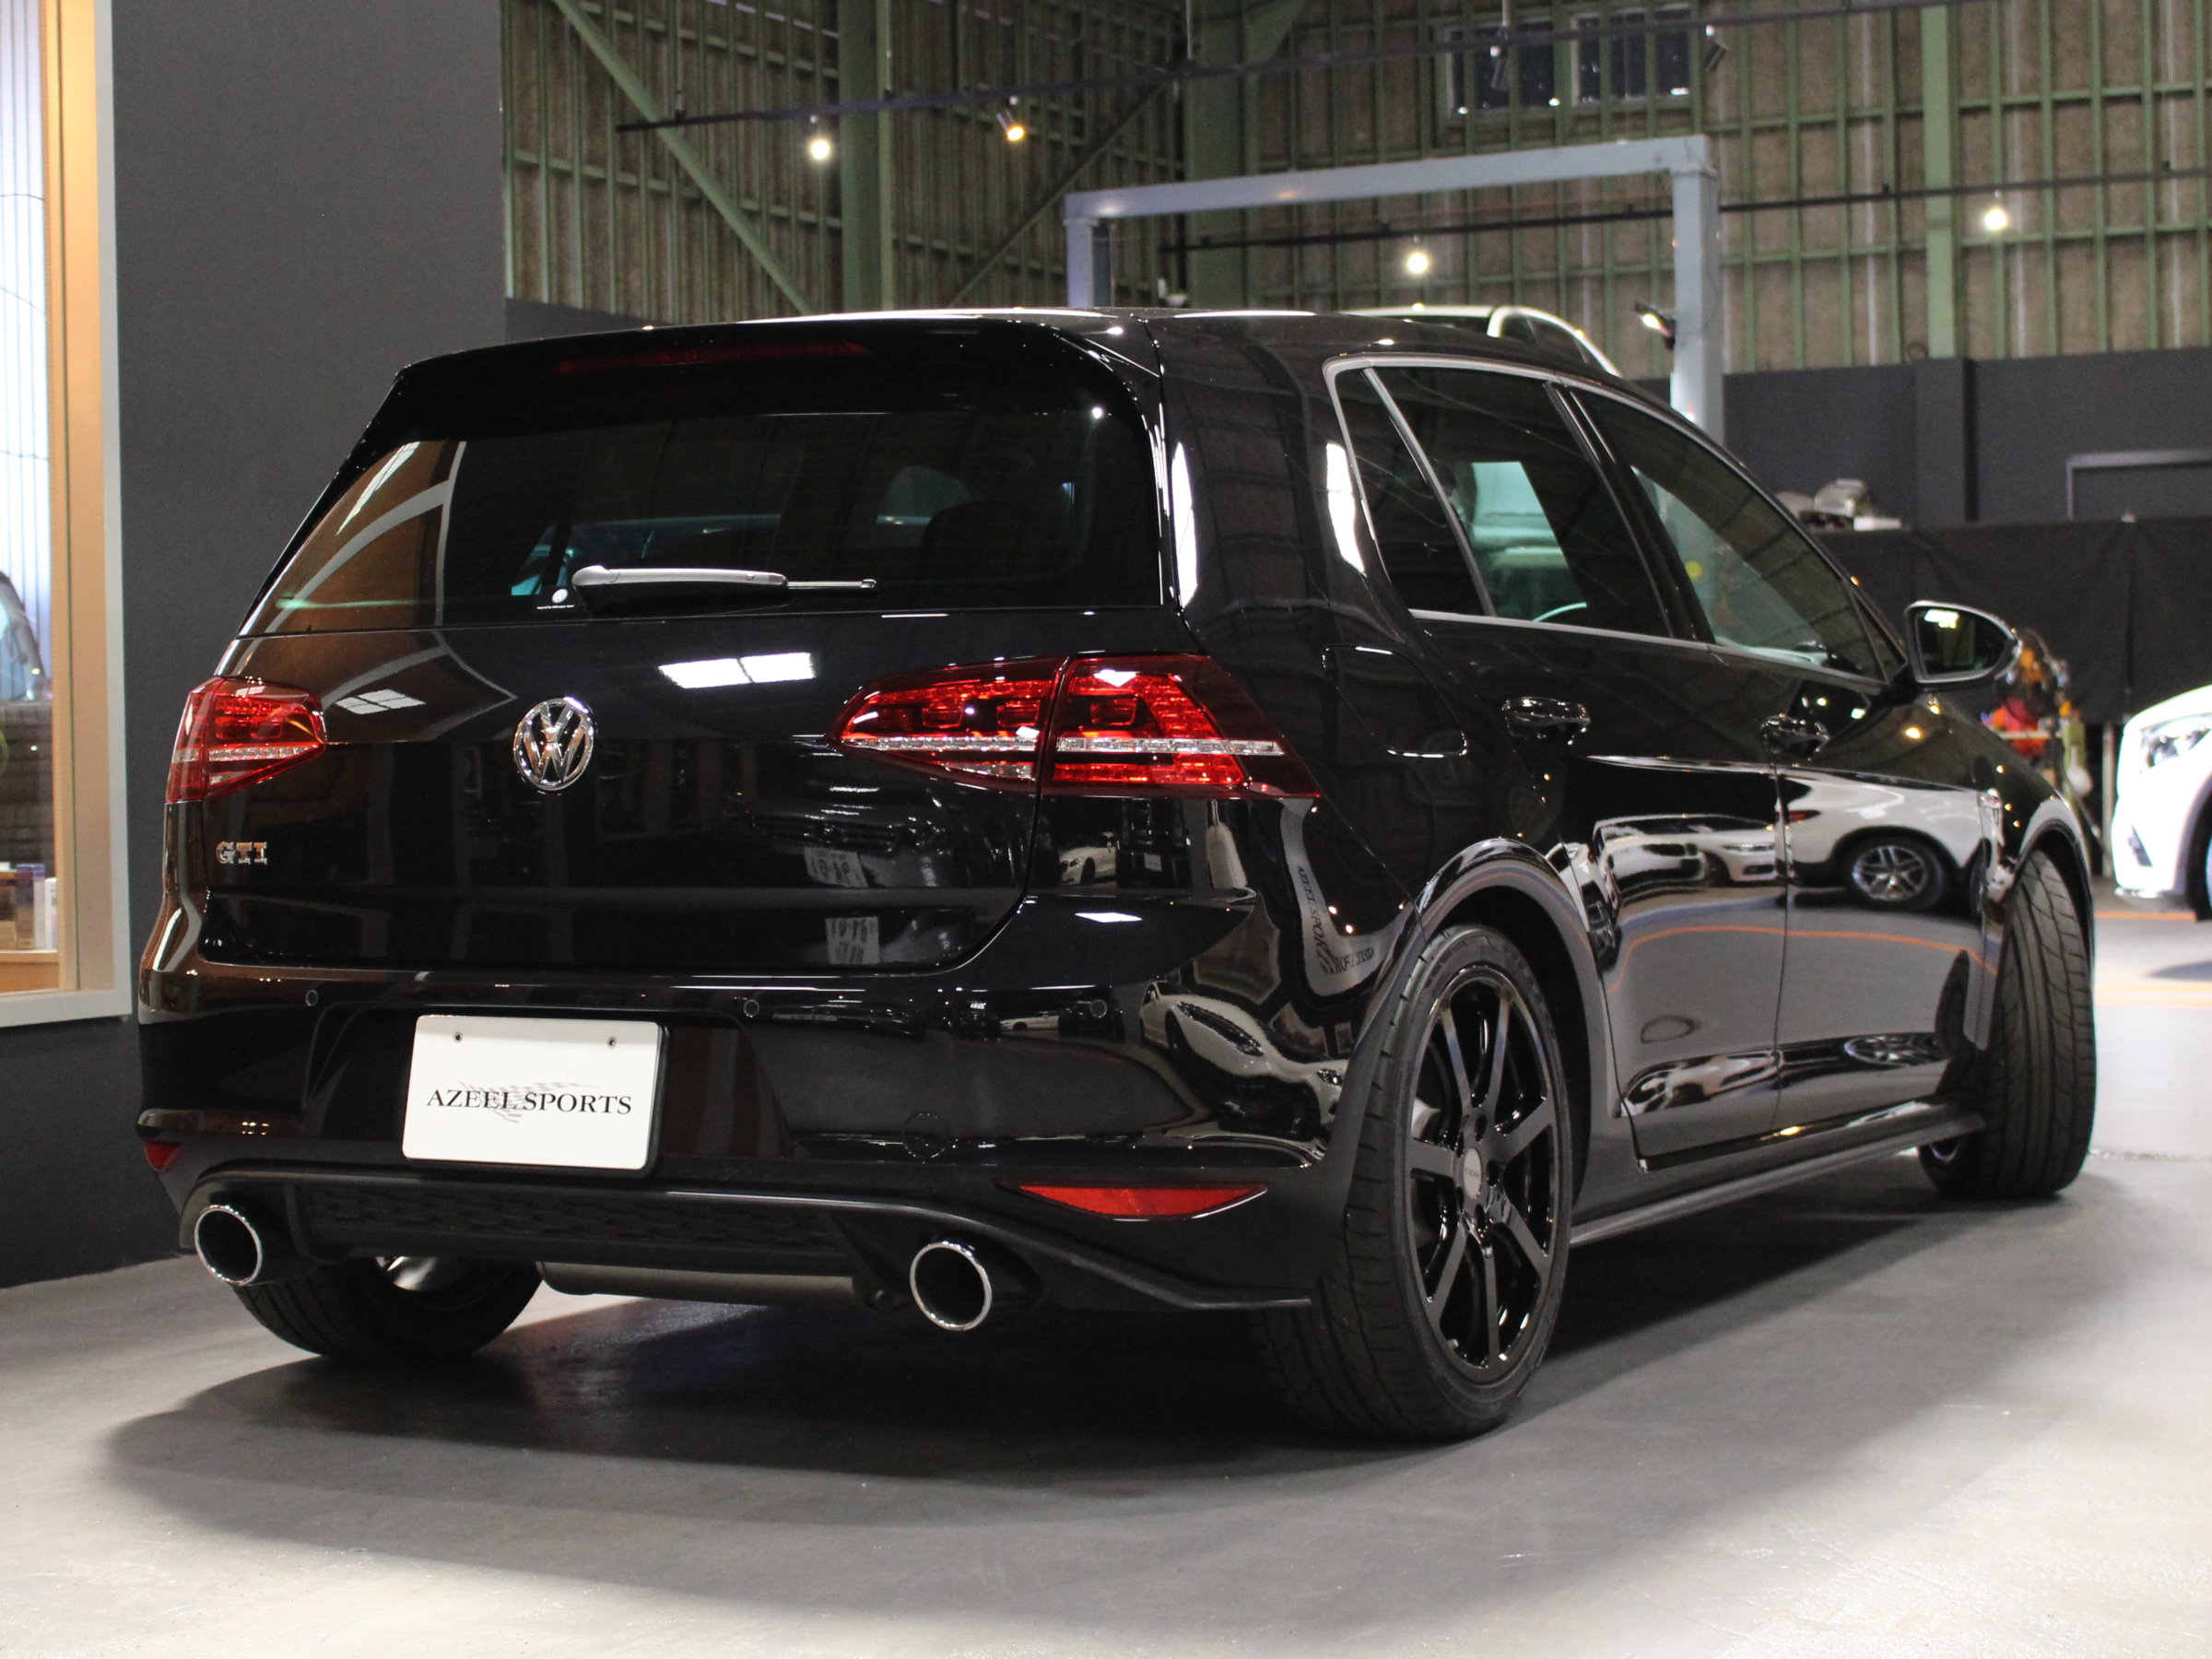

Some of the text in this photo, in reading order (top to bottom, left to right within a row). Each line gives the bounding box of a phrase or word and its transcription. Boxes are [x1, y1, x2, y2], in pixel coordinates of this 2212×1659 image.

[215, 841, 268, 865] GTI
[426, 1088, 632, 1115] AZEEL SPORTS
